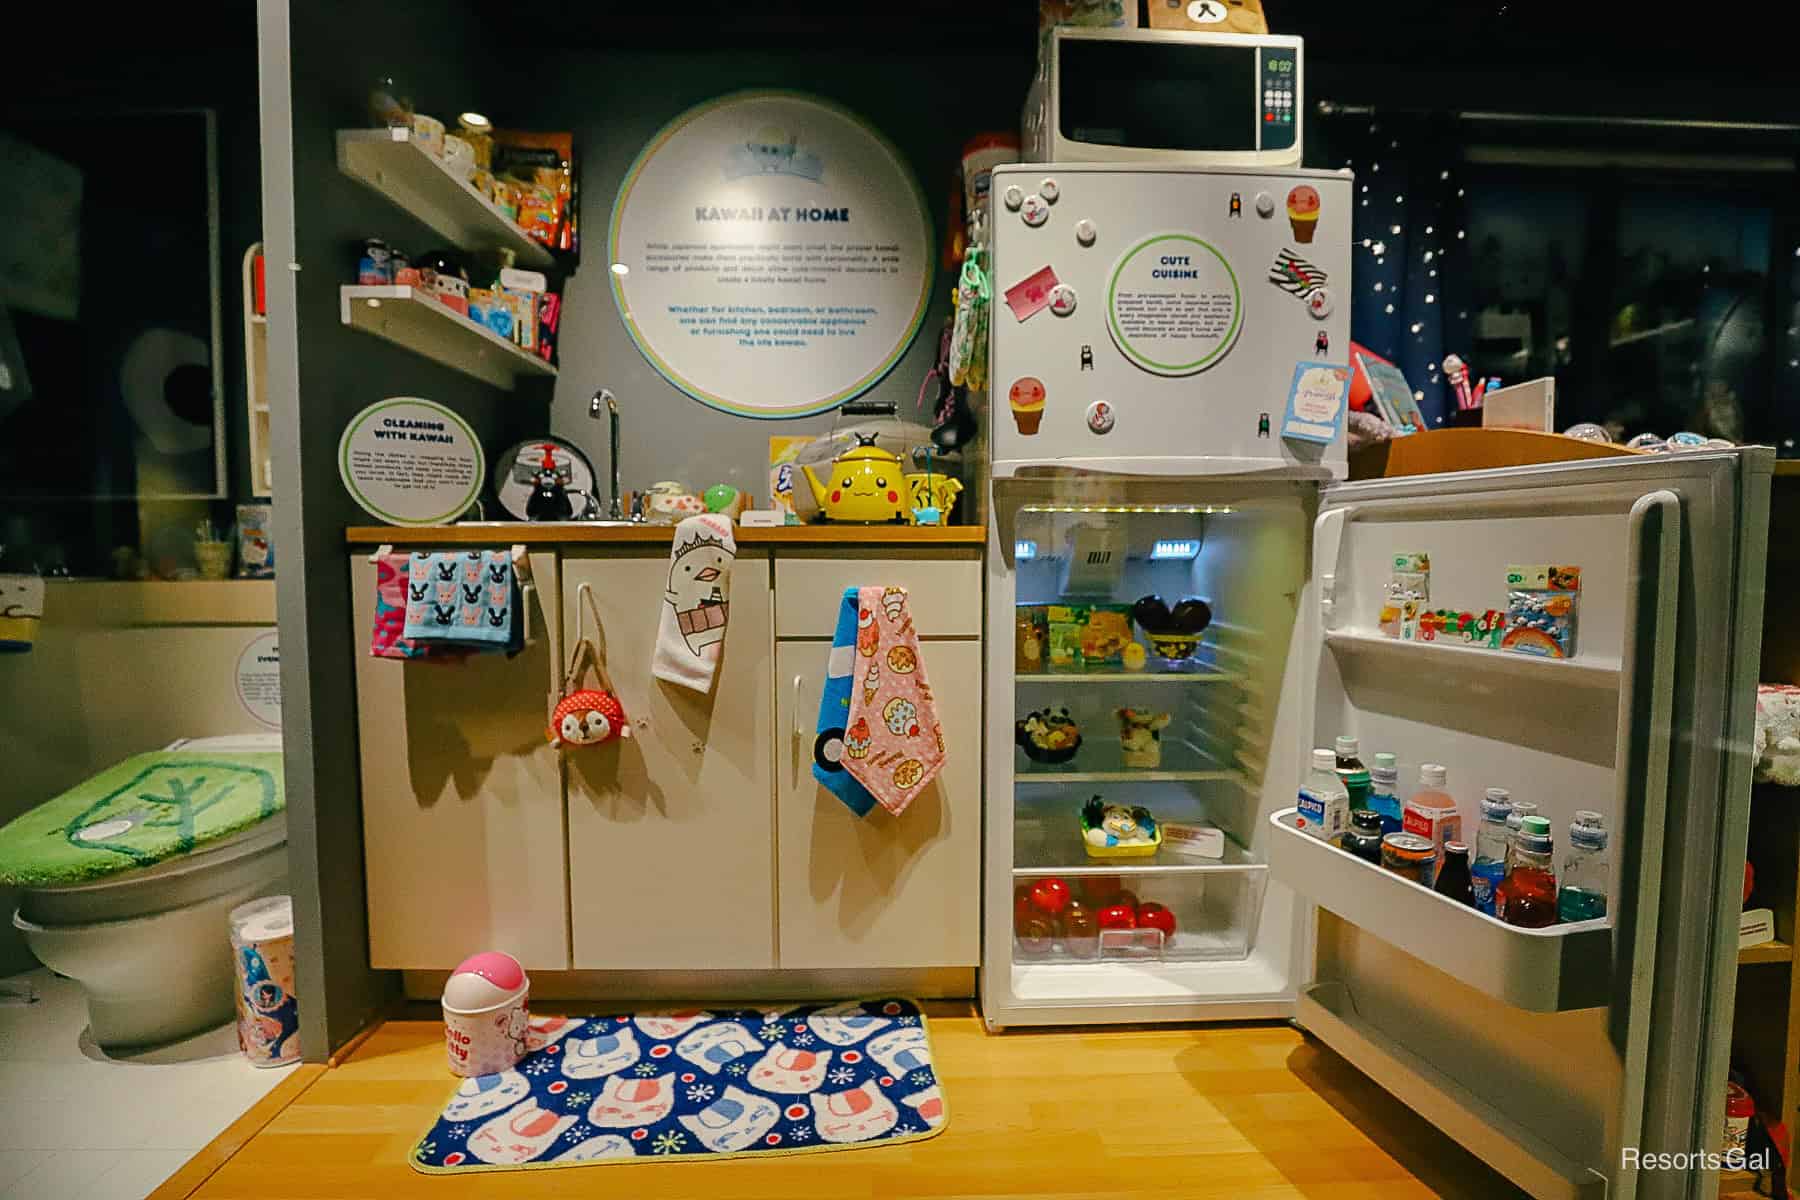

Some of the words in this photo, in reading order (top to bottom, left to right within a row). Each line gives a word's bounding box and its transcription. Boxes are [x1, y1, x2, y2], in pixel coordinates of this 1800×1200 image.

[695, 207, 763, 222] KAWAII
[767, 207, 790, 222] AT
[796, 207, 849, 222] HOME
[1160, 256, 1190, 266] CUTE
[1152, 269, 1198, 279] CUISINE
[667, 305, 709, 314] Whether
[383, 418, 444, 431] CLEANING
[374, 429, 406, 441] WITH
[410, 430, 453, 444] KAWAII
